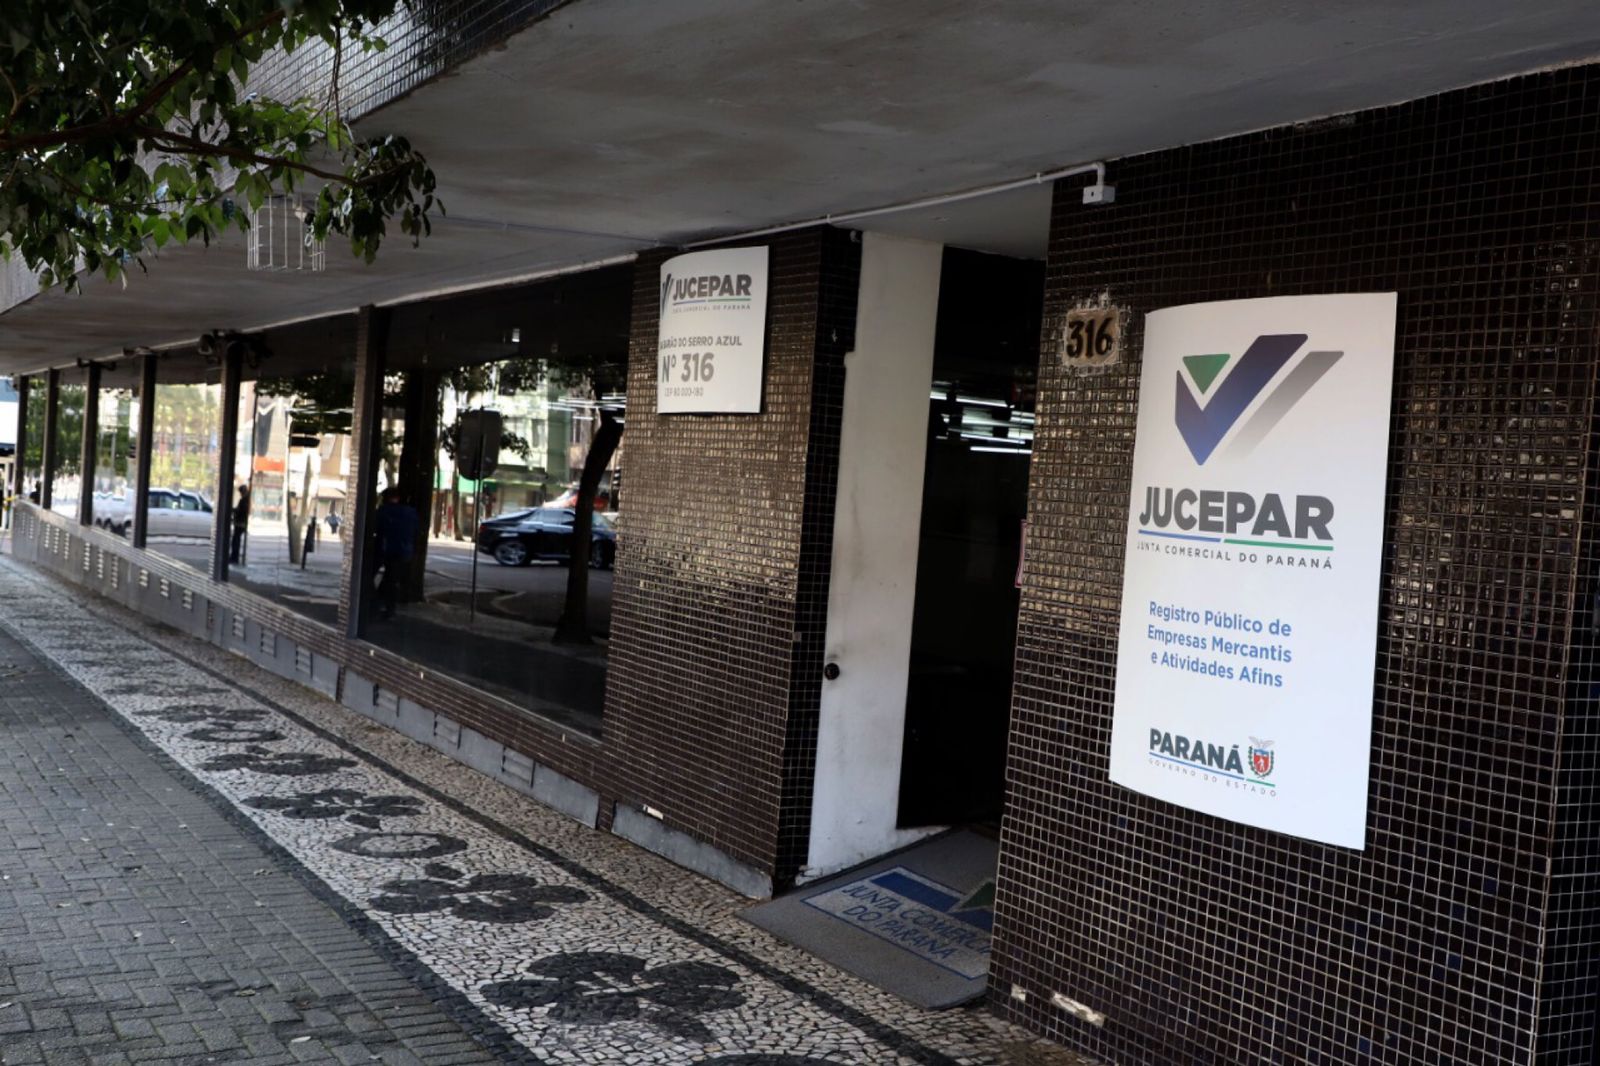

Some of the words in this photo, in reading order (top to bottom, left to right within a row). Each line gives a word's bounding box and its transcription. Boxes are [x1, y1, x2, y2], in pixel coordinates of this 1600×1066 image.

[672, 274, 752, 301] JUCEPAR
[688, 336, 713, 347] SERRO
[715, 335, 742, 346] AZUL
[1066, 317, 1114, 359] 316
[681, 352, 714, 382] 316
[1139, 486, 1334, 541] JUCEPAR
[1136, 541, 1161, 553] JUNTA
[1165, 545, 1231, 562] COMERCIAL
[1239, 553, 1257, 563] DO
[1266, 555, 1332, 570] PARANÁ
[1149, 601, 1200, 622] Registro
[1204, 610, 1263, 633] Público
[1268, 618, 1292, 637] de
[1147, 624, 1207, 650] Empresas
[1211, 636, 1292, 663] Mercantis
[1151, 651, 1158, 664] e
[1160, 651, 1234, 679] Atividades
[1239, 666, 1283, 687] Afins
[1149, 728, 1244, 774] PARANÁ
[1148, 757, 1196, 777] GOVERNO
[1203, 773, 1218, 783] DO
[1226, 779, 1277, 798] ESTADO
[842, 884, 903, 913] JUNTA
[842, 904, 882, 922] DO
